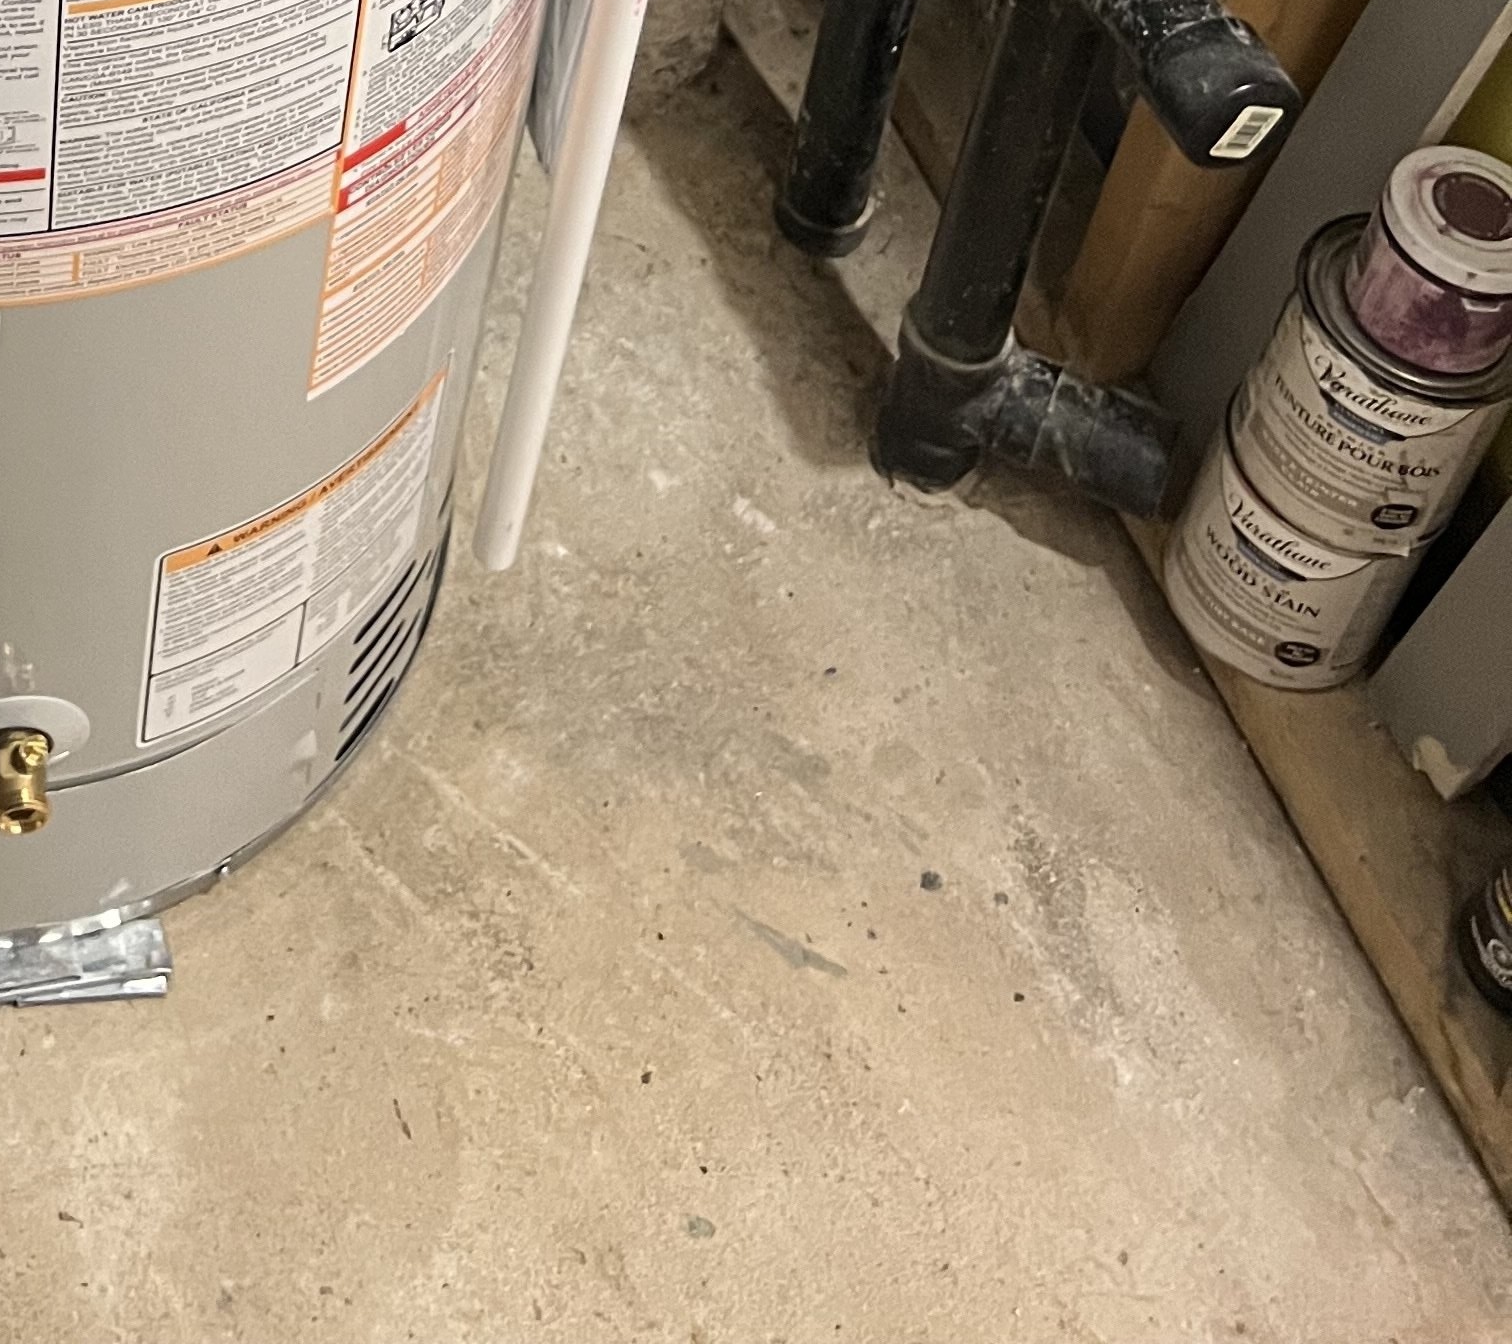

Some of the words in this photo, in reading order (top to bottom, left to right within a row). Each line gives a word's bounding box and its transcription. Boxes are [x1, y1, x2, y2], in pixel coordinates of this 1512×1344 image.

[64, 16, 85, 24] HOT
[88, 11, 125, 21] WATER
[127, 5, 149, 14] CAN
[1315, 355, 1433, 426] Varathane
[1338, 439, 1392, 473] POUR
[1232, 499, 1332, 571] Varathane
[1207, 525, 1256, 587] WOOD
[1263, 584, 1321, 618] STAIN
